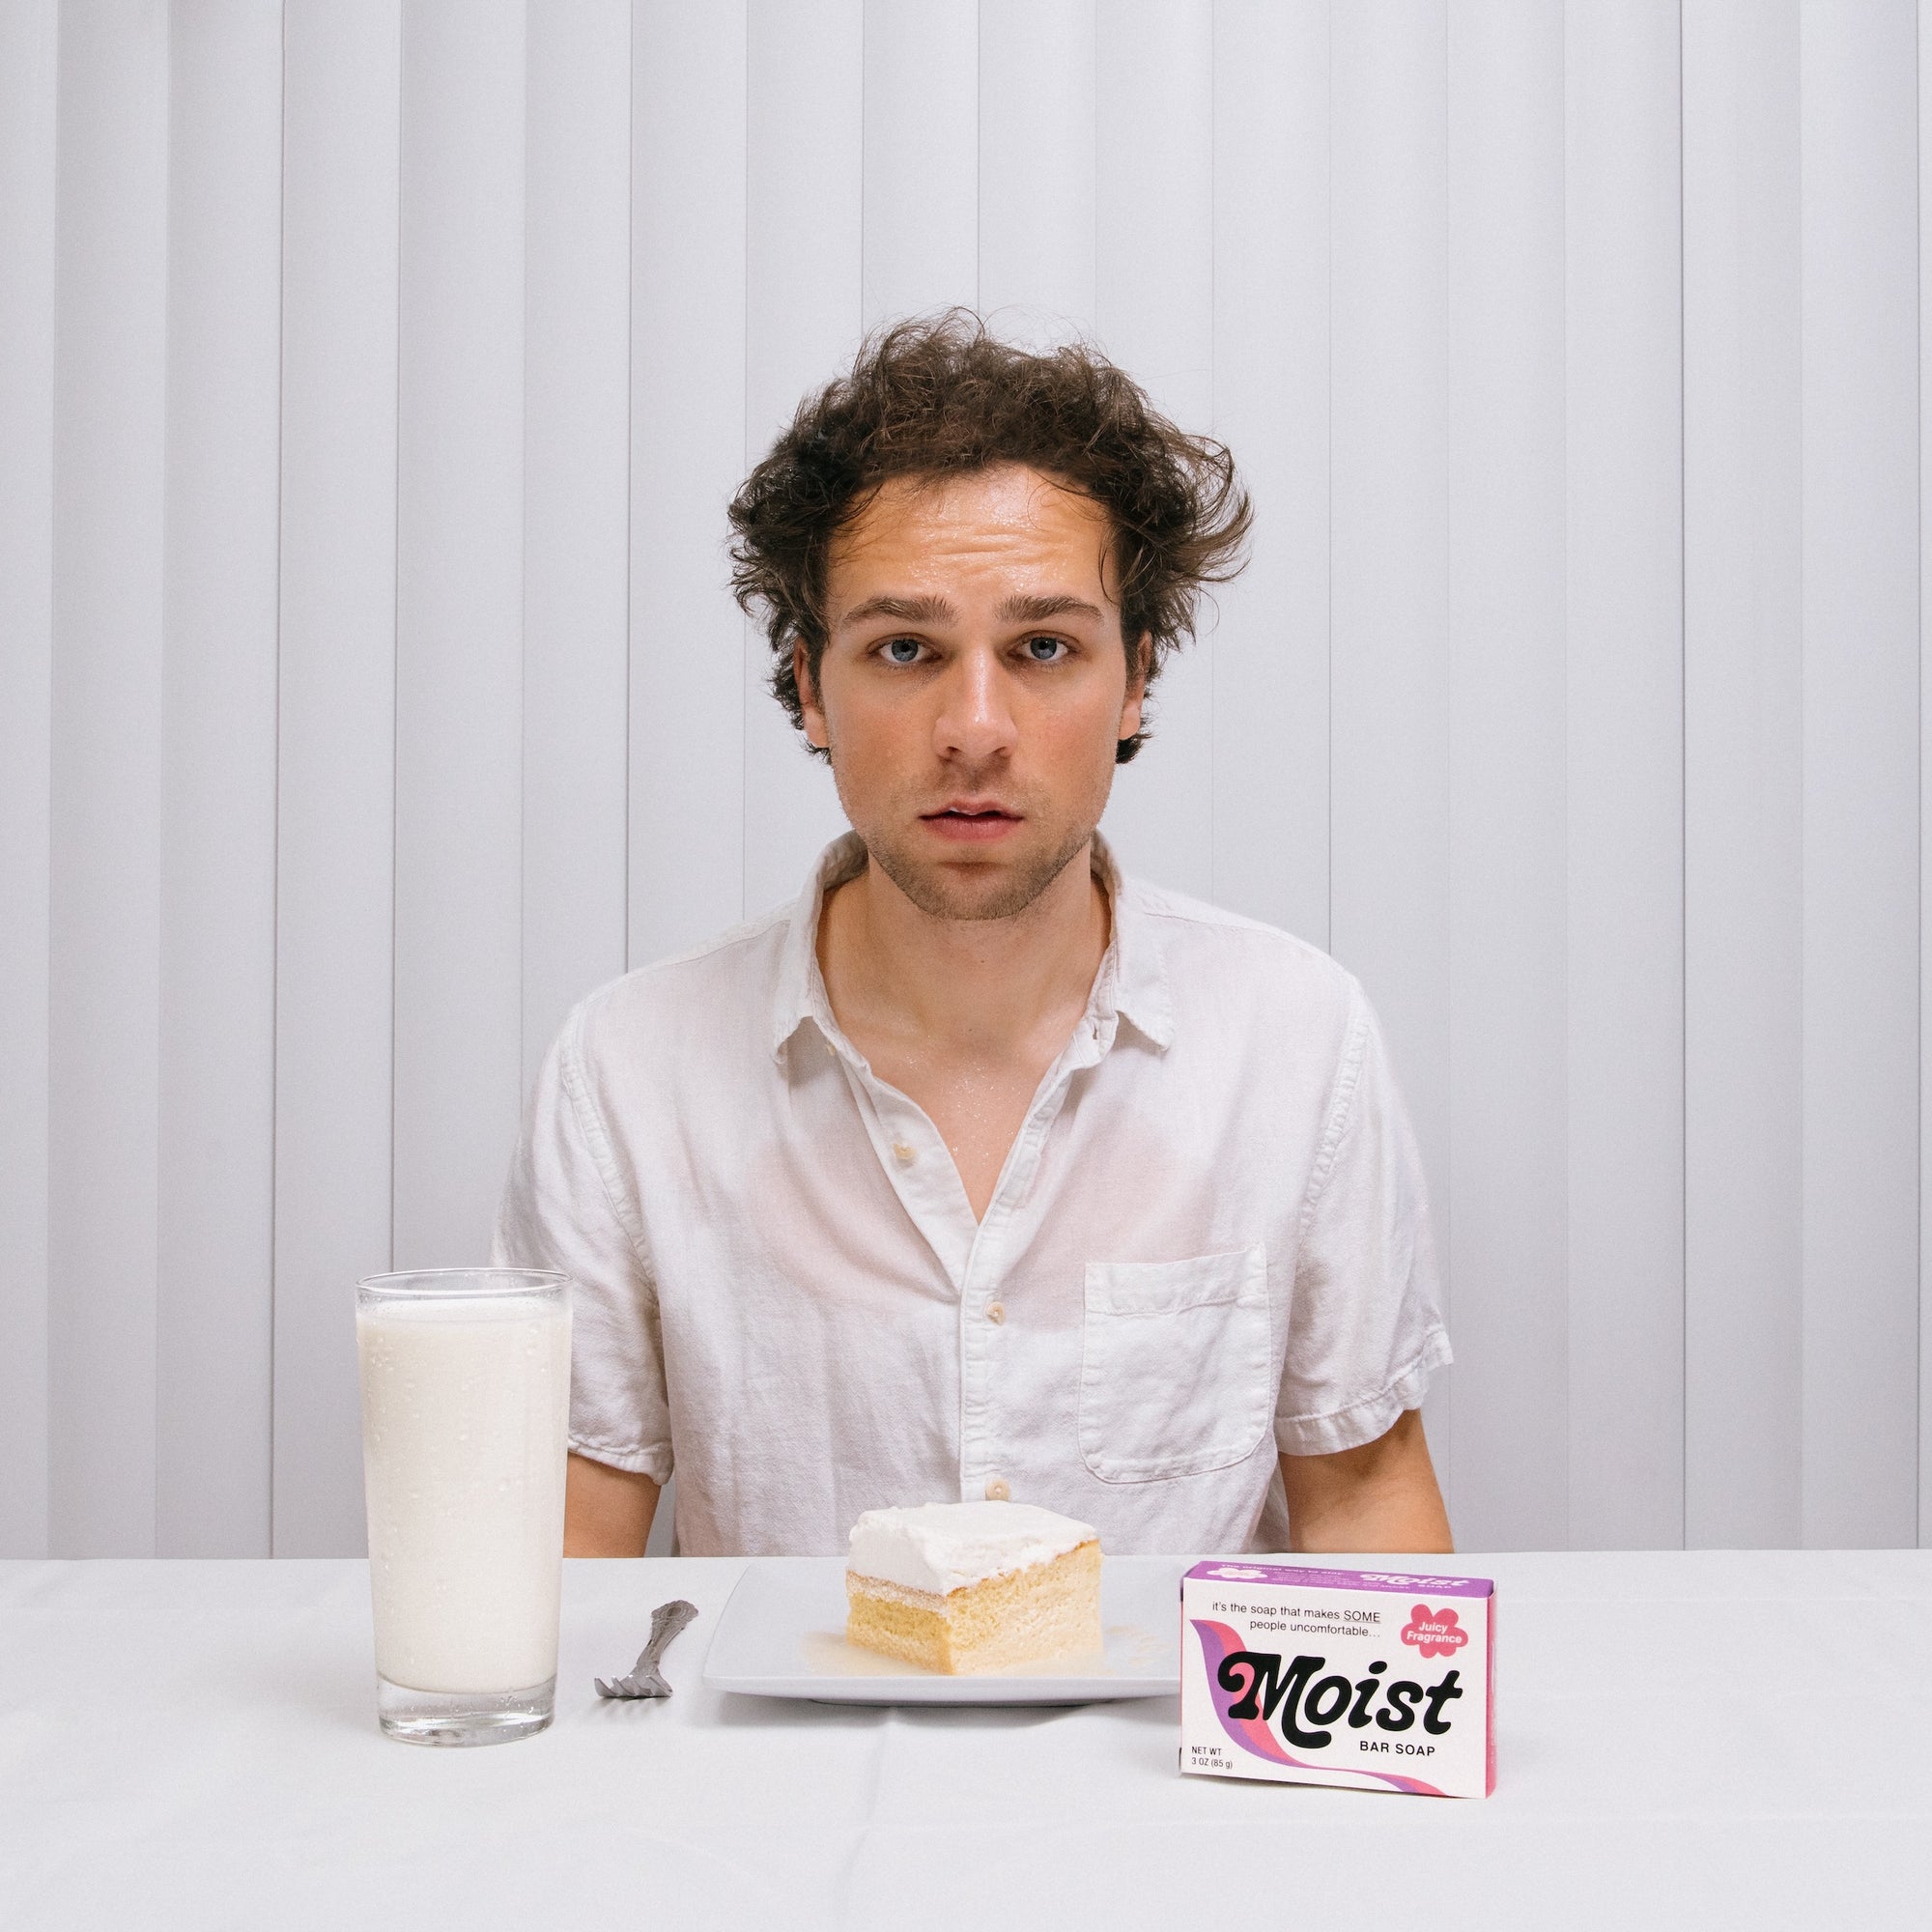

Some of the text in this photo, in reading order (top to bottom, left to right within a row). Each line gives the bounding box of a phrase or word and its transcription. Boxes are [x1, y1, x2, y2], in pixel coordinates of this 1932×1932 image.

[1359, 1574, 1469, 1586] Moist
[1212, 1601, 1381, 1624] it's the soap that makes SOME
[1250, 1620, 1287, 1632] people
[1418, 1621, 1448, 1634] Juicy
[1406, 1630, 1463, 1644] Fragrance
[1217, 1651, 1463, 1749] Moist
[1191, 1746, 1222, 1756] NET WT
[1359, 1740, 1435, 1756] BAR SOAP
[1191, 1756, 1234, 1770] 3 OZ (85 g)
